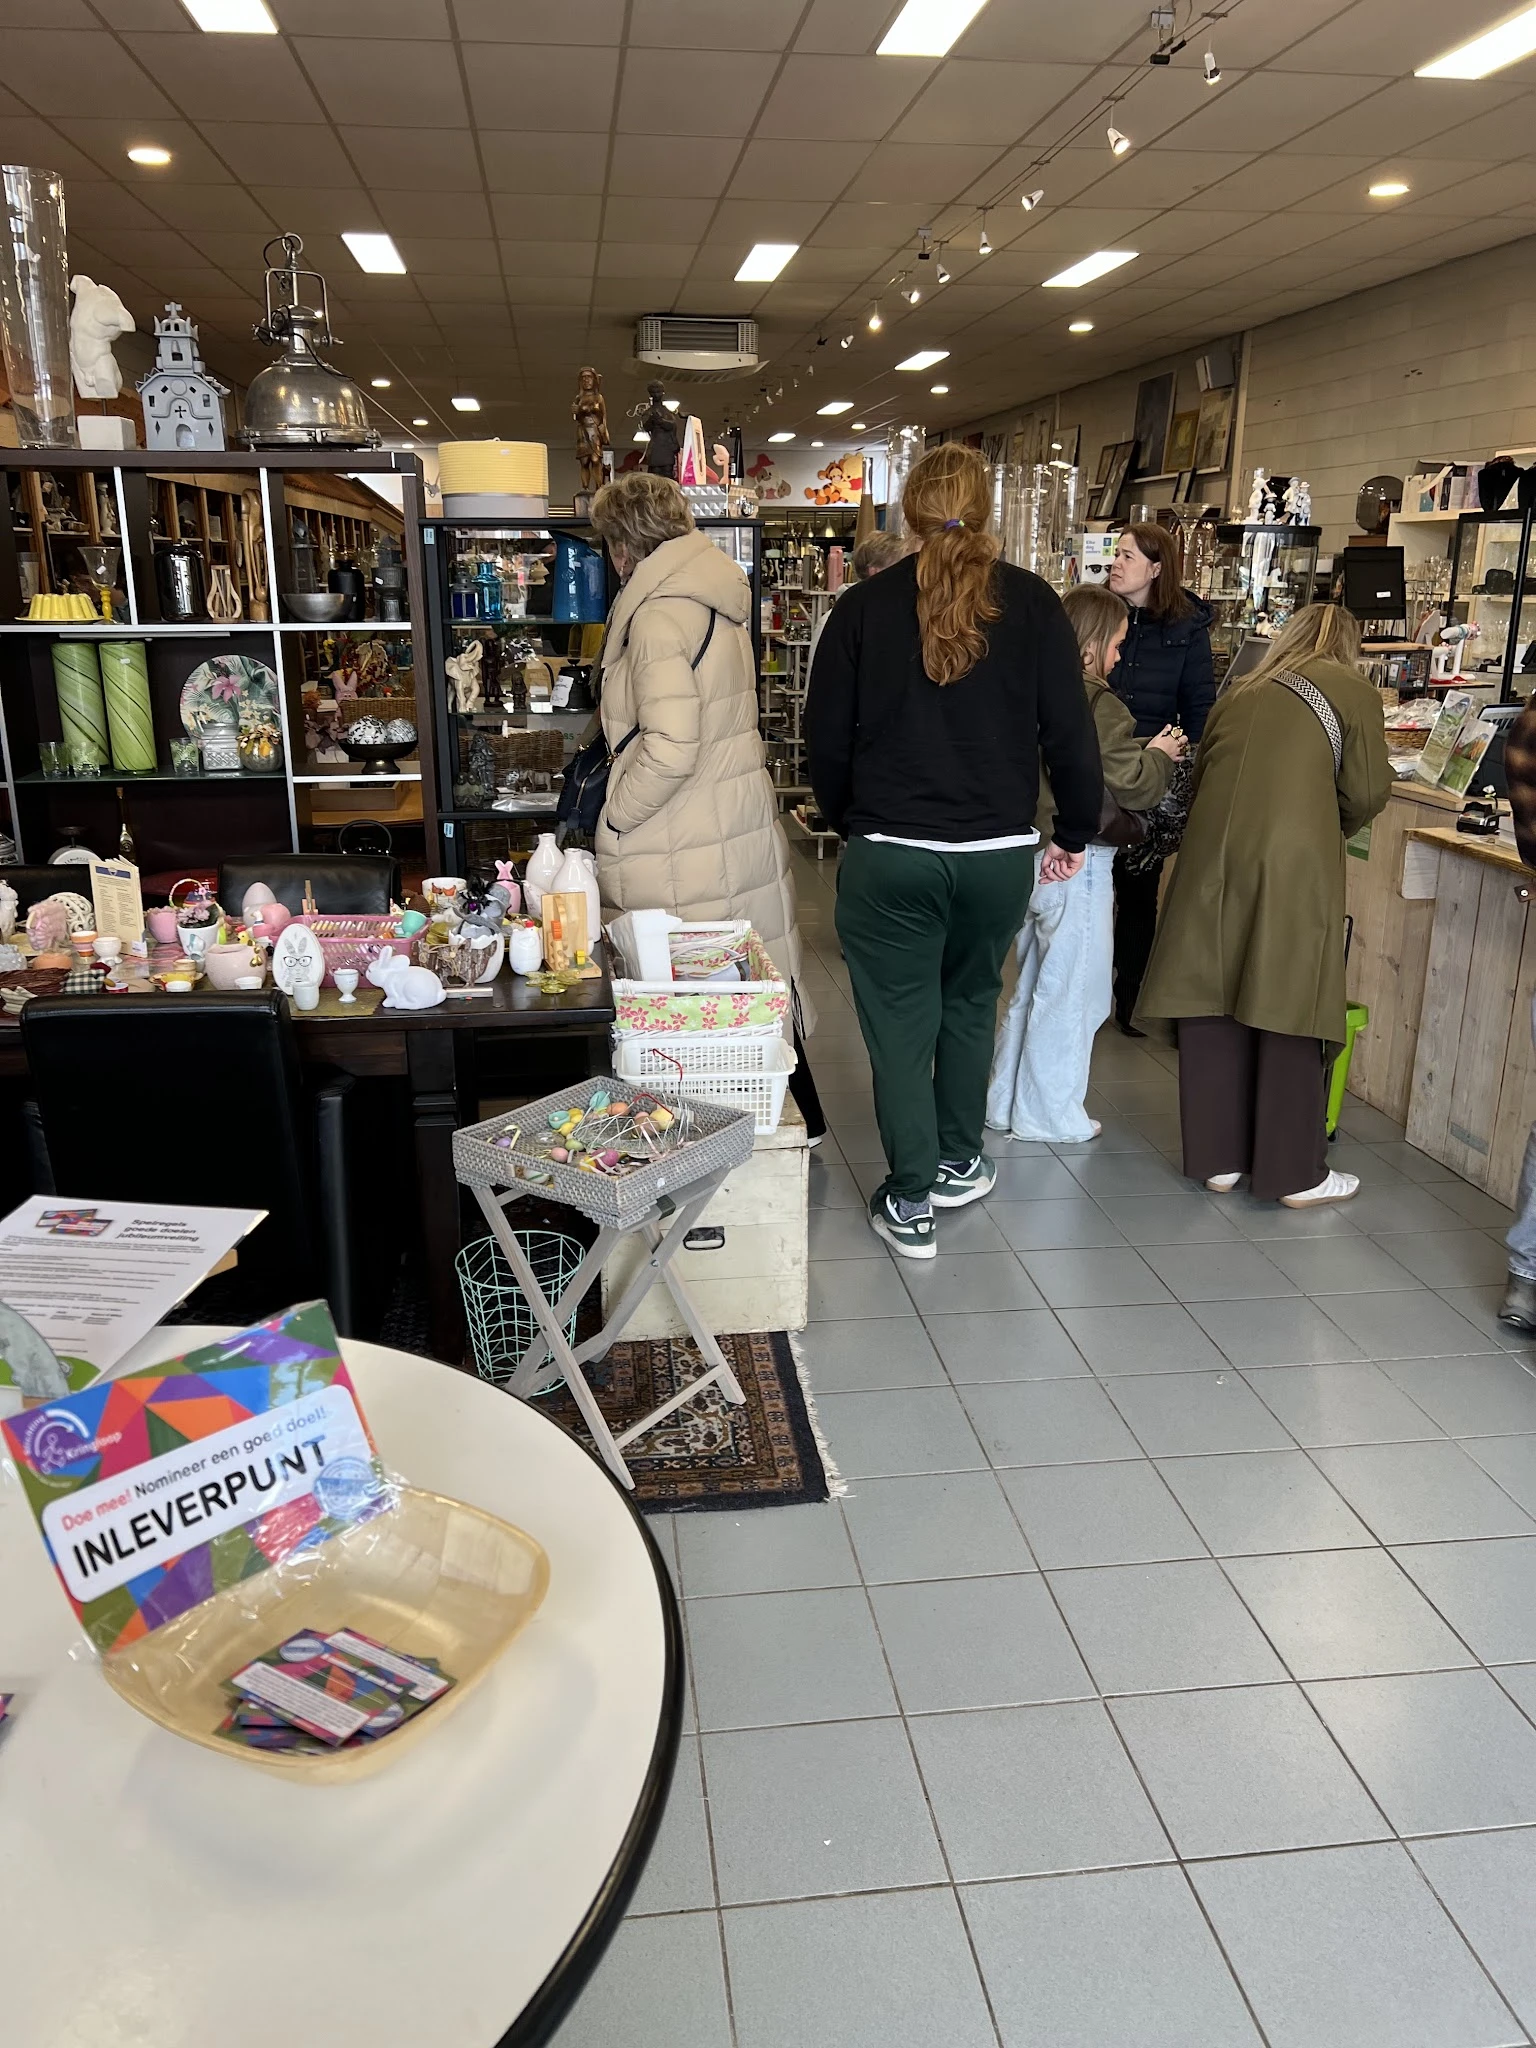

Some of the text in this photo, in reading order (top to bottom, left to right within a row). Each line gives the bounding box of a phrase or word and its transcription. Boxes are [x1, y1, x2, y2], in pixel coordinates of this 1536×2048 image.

[115, 1233, 200, 1243] jubileumveiling
[131, 1219, 188, 1228] Spelregels
[61, 1406, 328, 1532] Doe mee! Nomineer een goed doel!
[71, 1434, 327, 1577] INLEVERPUNT
